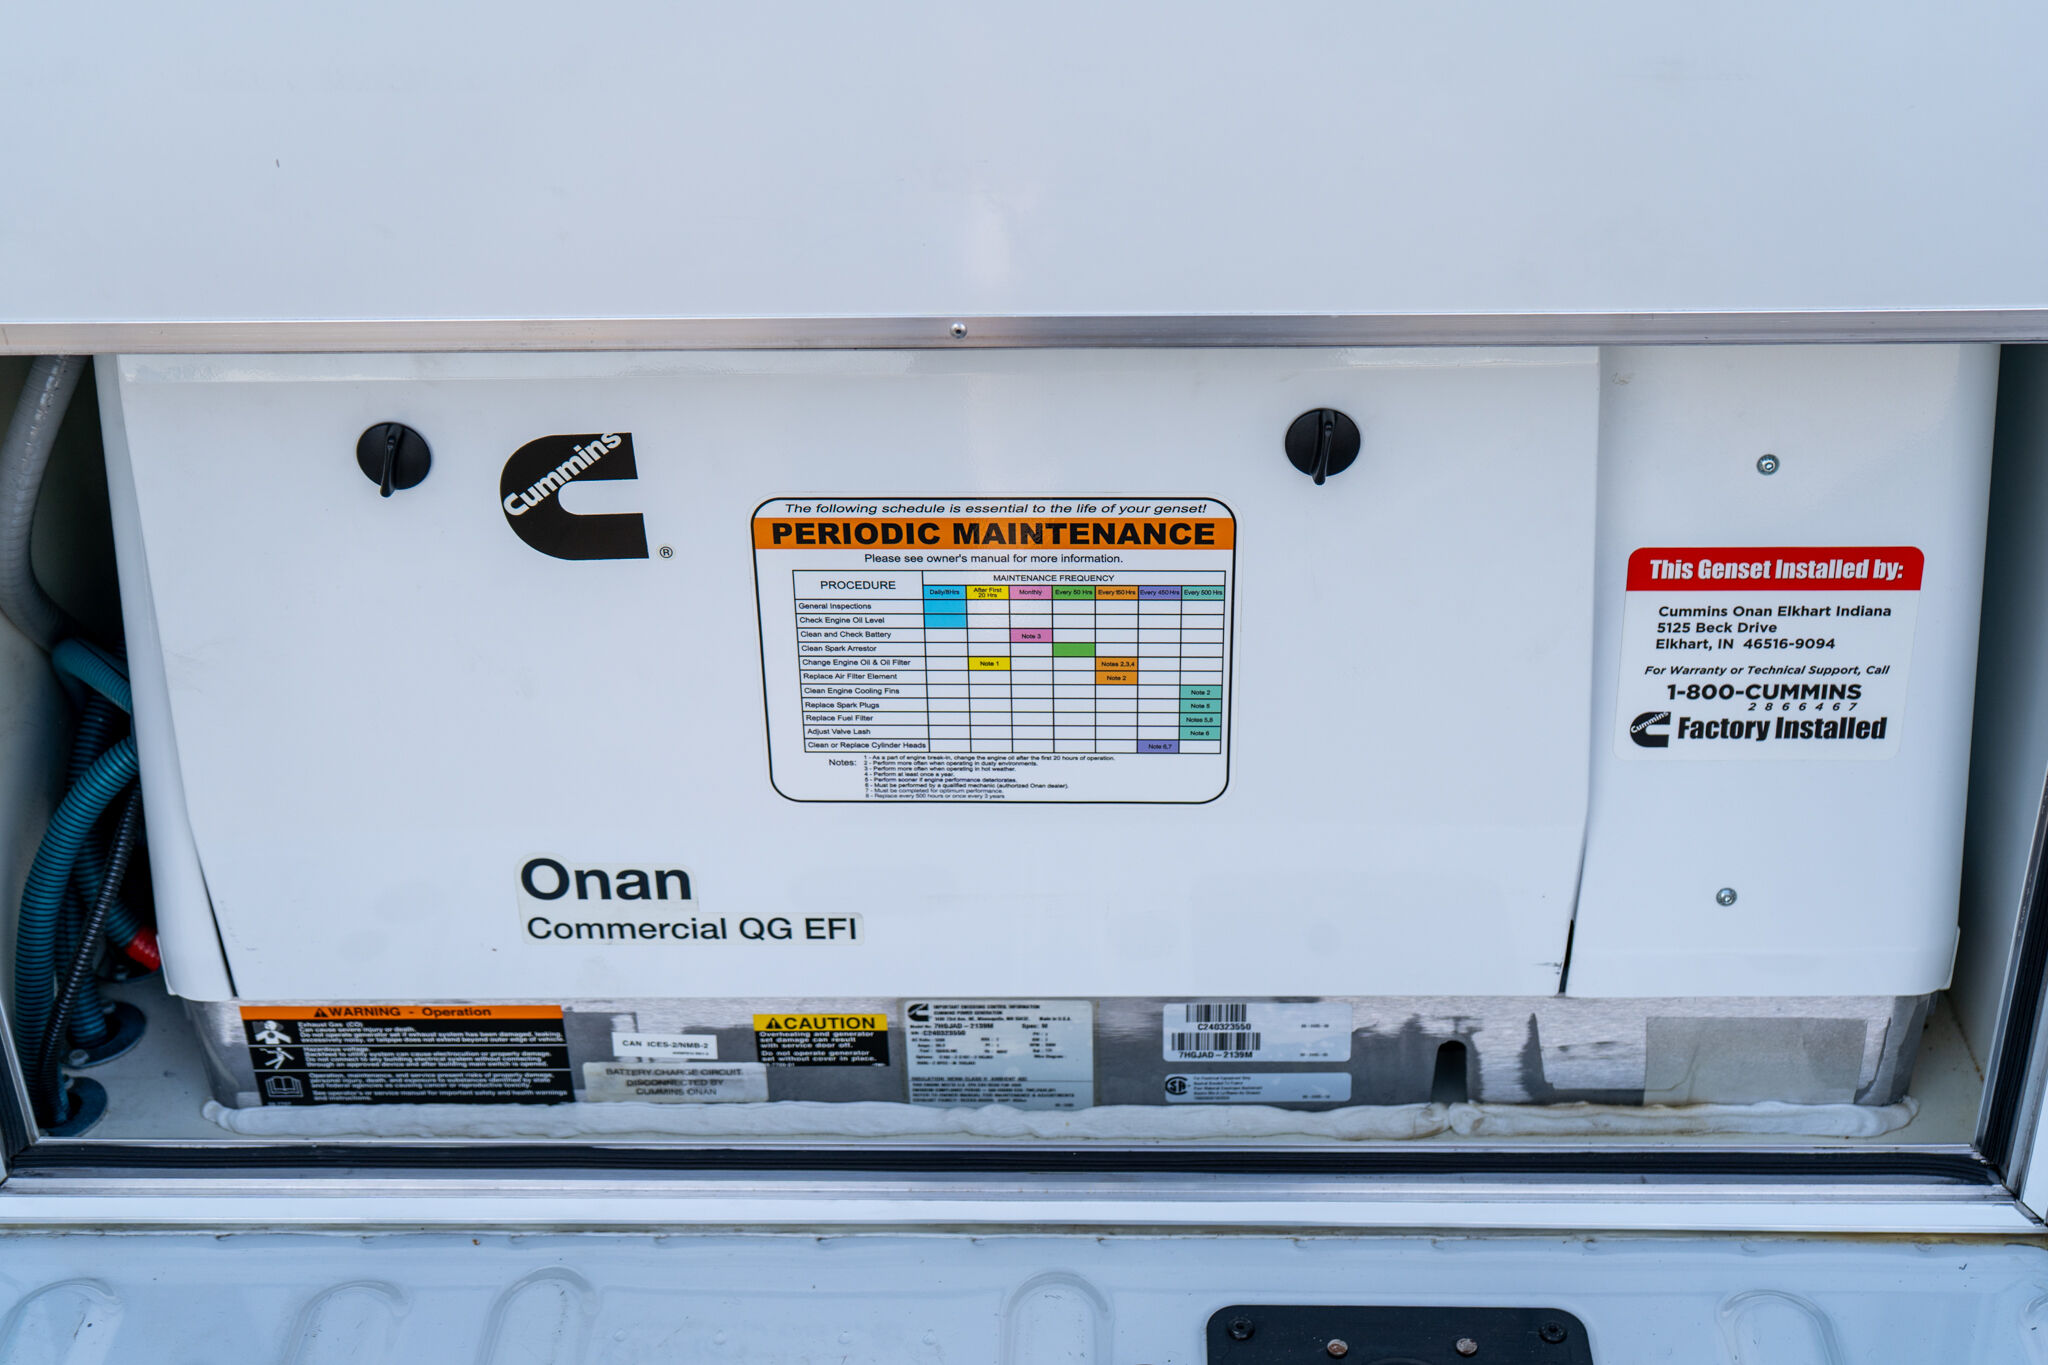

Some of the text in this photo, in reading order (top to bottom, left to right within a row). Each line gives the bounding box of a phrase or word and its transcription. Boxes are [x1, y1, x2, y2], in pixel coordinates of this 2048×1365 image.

[503, 433, 622, 516] Cummins
[786, 504, 1206, 515] The following schedule is essential to the life of your genset!
[772, 523, 1215, 544] PERIODIC MAINTENANCE
[865, 554, 1123, 563] Please see owner's manual for more information.
[1650, 559, 1903, 581] This Genset Installed by:
[821, 581, 896, 589] PROCEDURE
[1659, 606, 1891, 616] Cummins Onan Elkhart Indiana
[1657, 622, 1777, 632] 5125 Beck Drive
[1656, 639, 1835, 651] Elkhart, IN 46516-9094
[1645, 666, 1666, 675] For
[1671, 666, 1727, 676] Warranty
[1748, 666, 1806, 675] Technical
[1808, 666, 1861, 676] Support,
[1866, 665, 1890, 675] Call
[1667, 684, 1862, 700] 1-800-CUMMINS
[1678, 717, 1887, 741] Factory Installed
[521, 858, 691, 900] Onan
[528, 917, 856, 941] Commercial QG EFI
[328, 1008, 491, 1018] WARNING Operation
[784, 1018, 875, 1029] CAUTION
